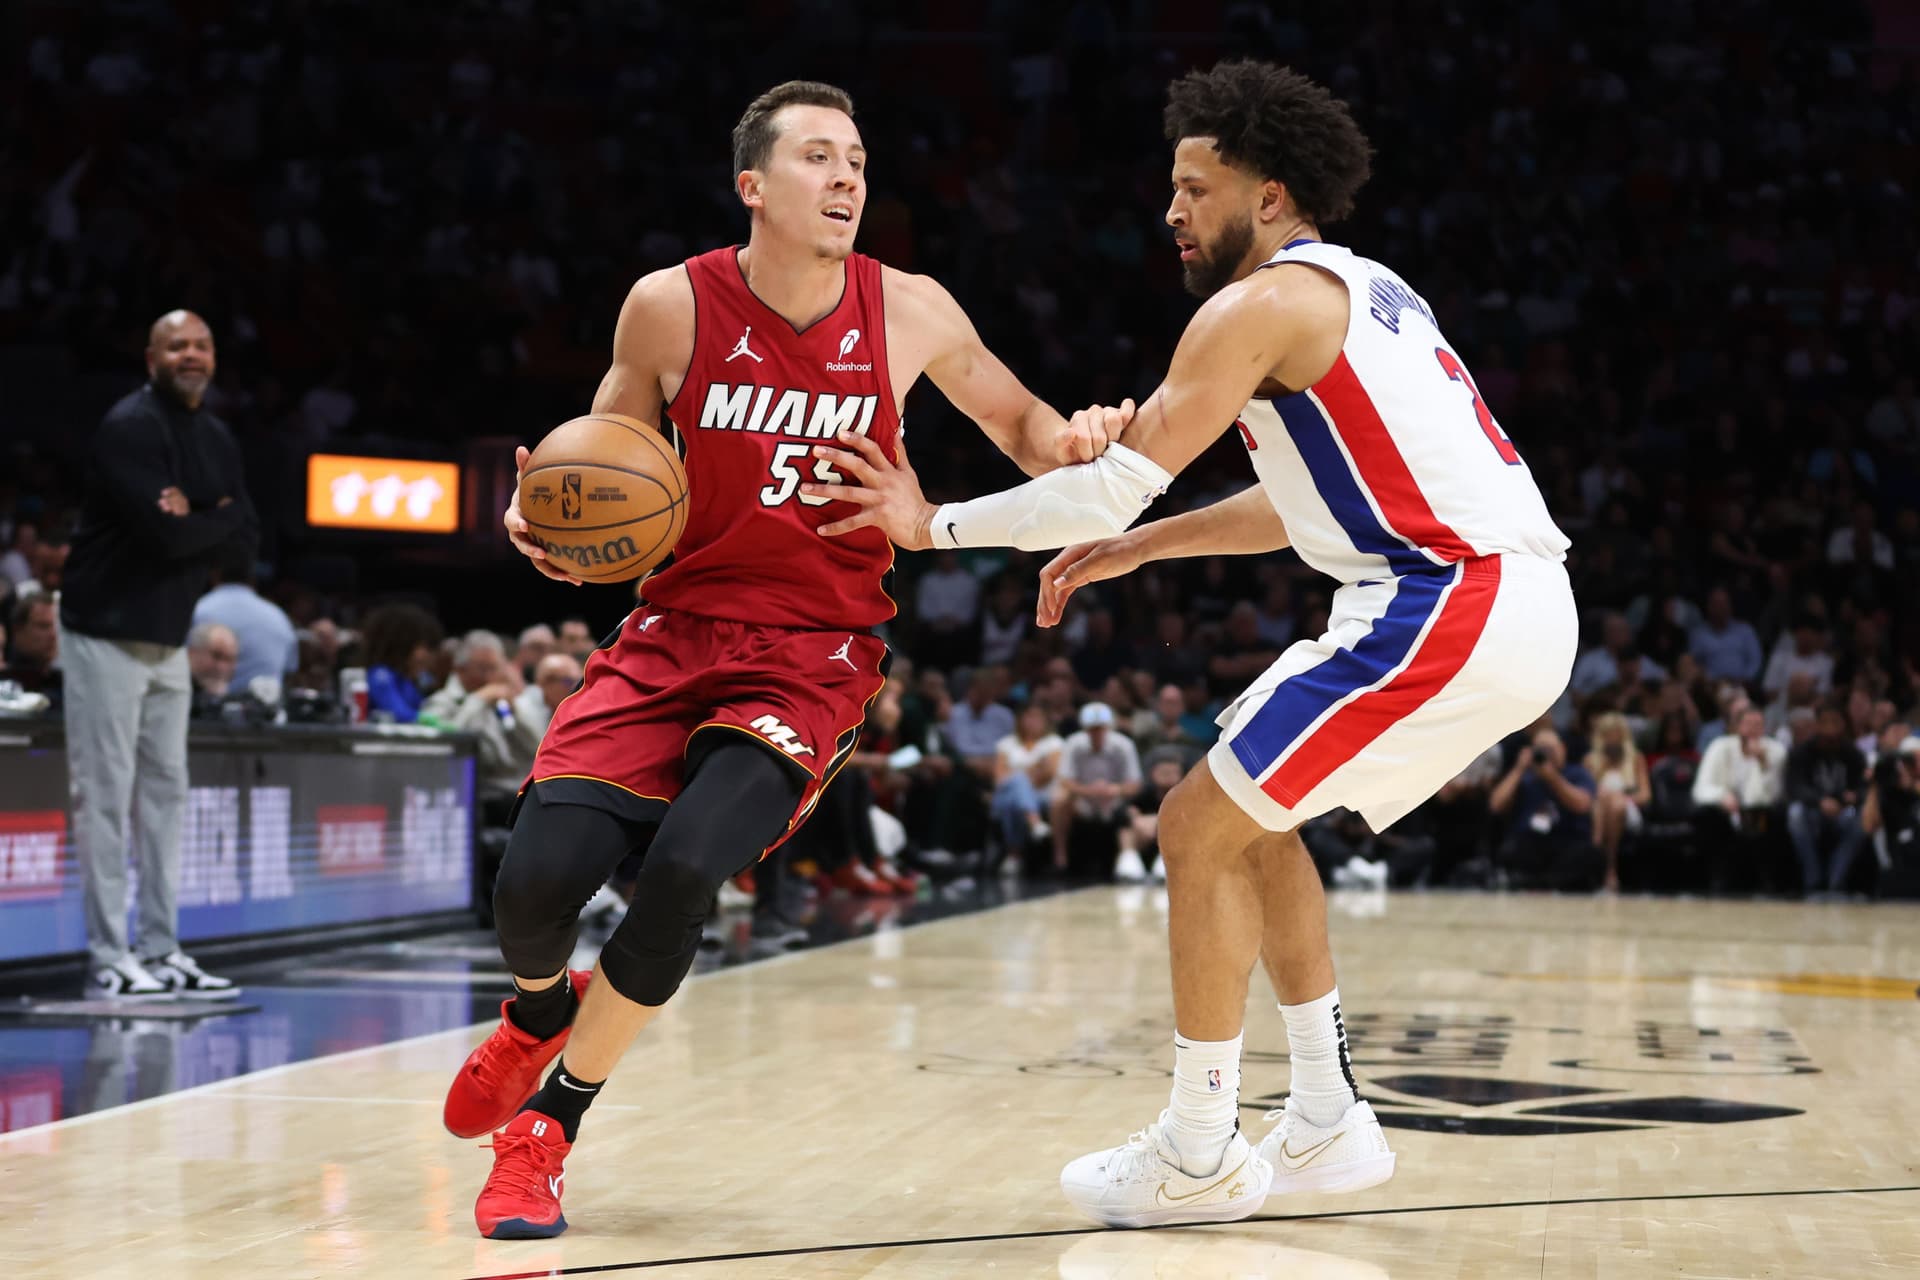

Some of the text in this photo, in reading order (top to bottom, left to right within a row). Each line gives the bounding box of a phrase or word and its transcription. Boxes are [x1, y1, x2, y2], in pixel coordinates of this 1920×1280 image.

[826, 361, 872, 372] Robinhood
[699, 382, 879, 440] MIAMI
[1434, 346, 1521, 466] 2
